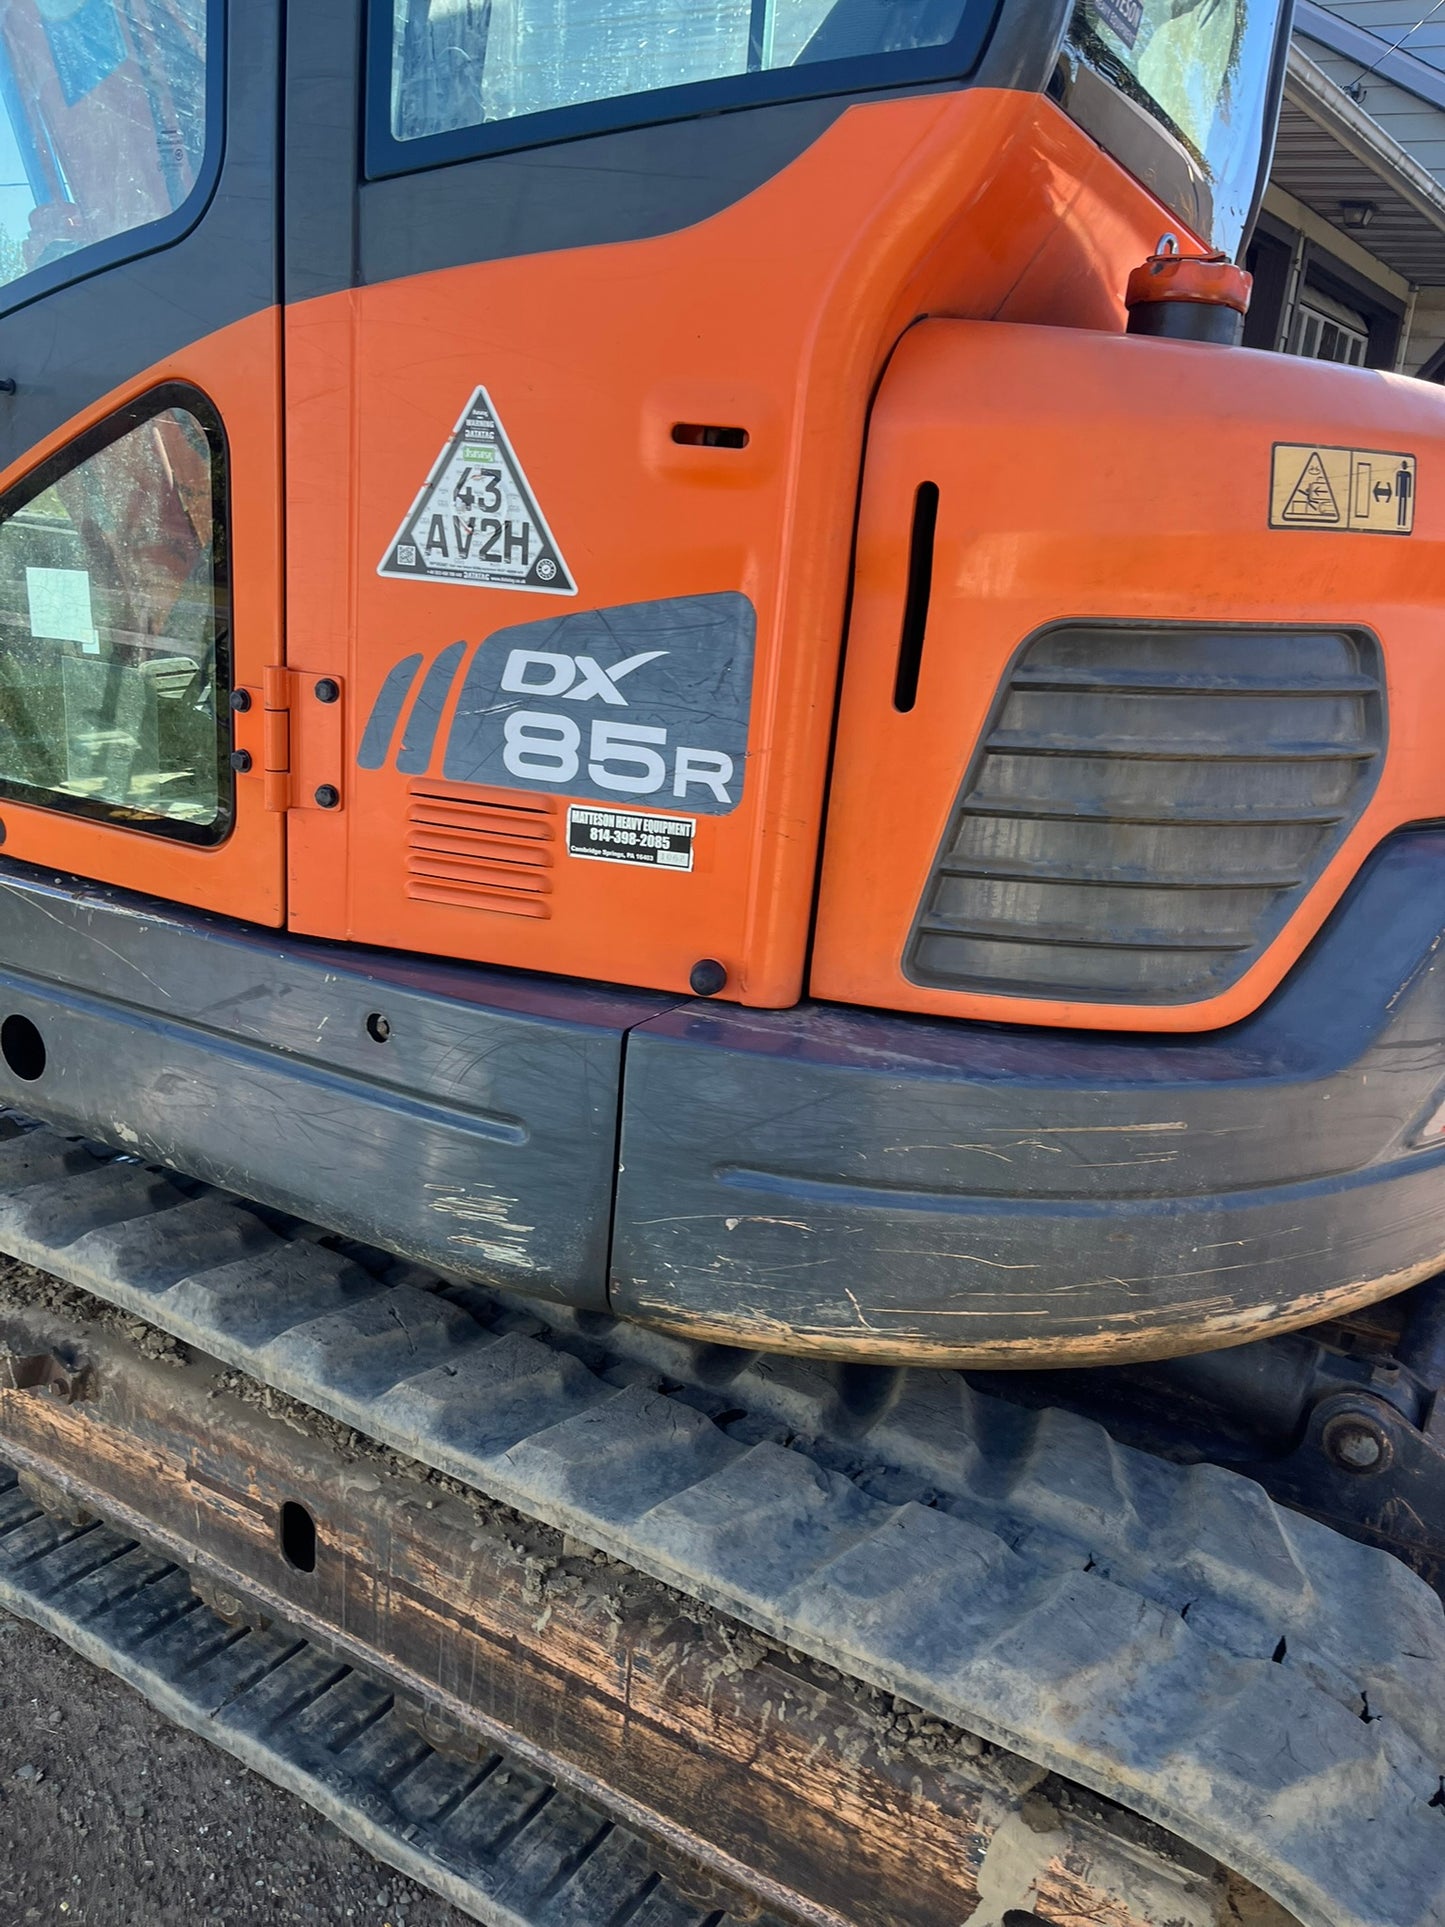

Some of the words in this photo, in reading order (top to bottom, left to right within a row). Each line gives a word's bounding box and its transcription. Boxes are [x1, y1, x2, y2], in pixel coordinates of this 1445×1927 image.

[453, 467, 502, 513] 43
[424, 513, 530, 566] AV2H
[501, 649, 671, 706] DX
[571, 809, 616, 828] MATTESON
[615, 814, 643, 831] HEAVY
[643, 818, 692, 837] EQUIPMENT
[589, 827, 671, 850] 814-398-2085
[570, 845, 602, 856] Cambridge
[626, 852, 636, 860] PA
